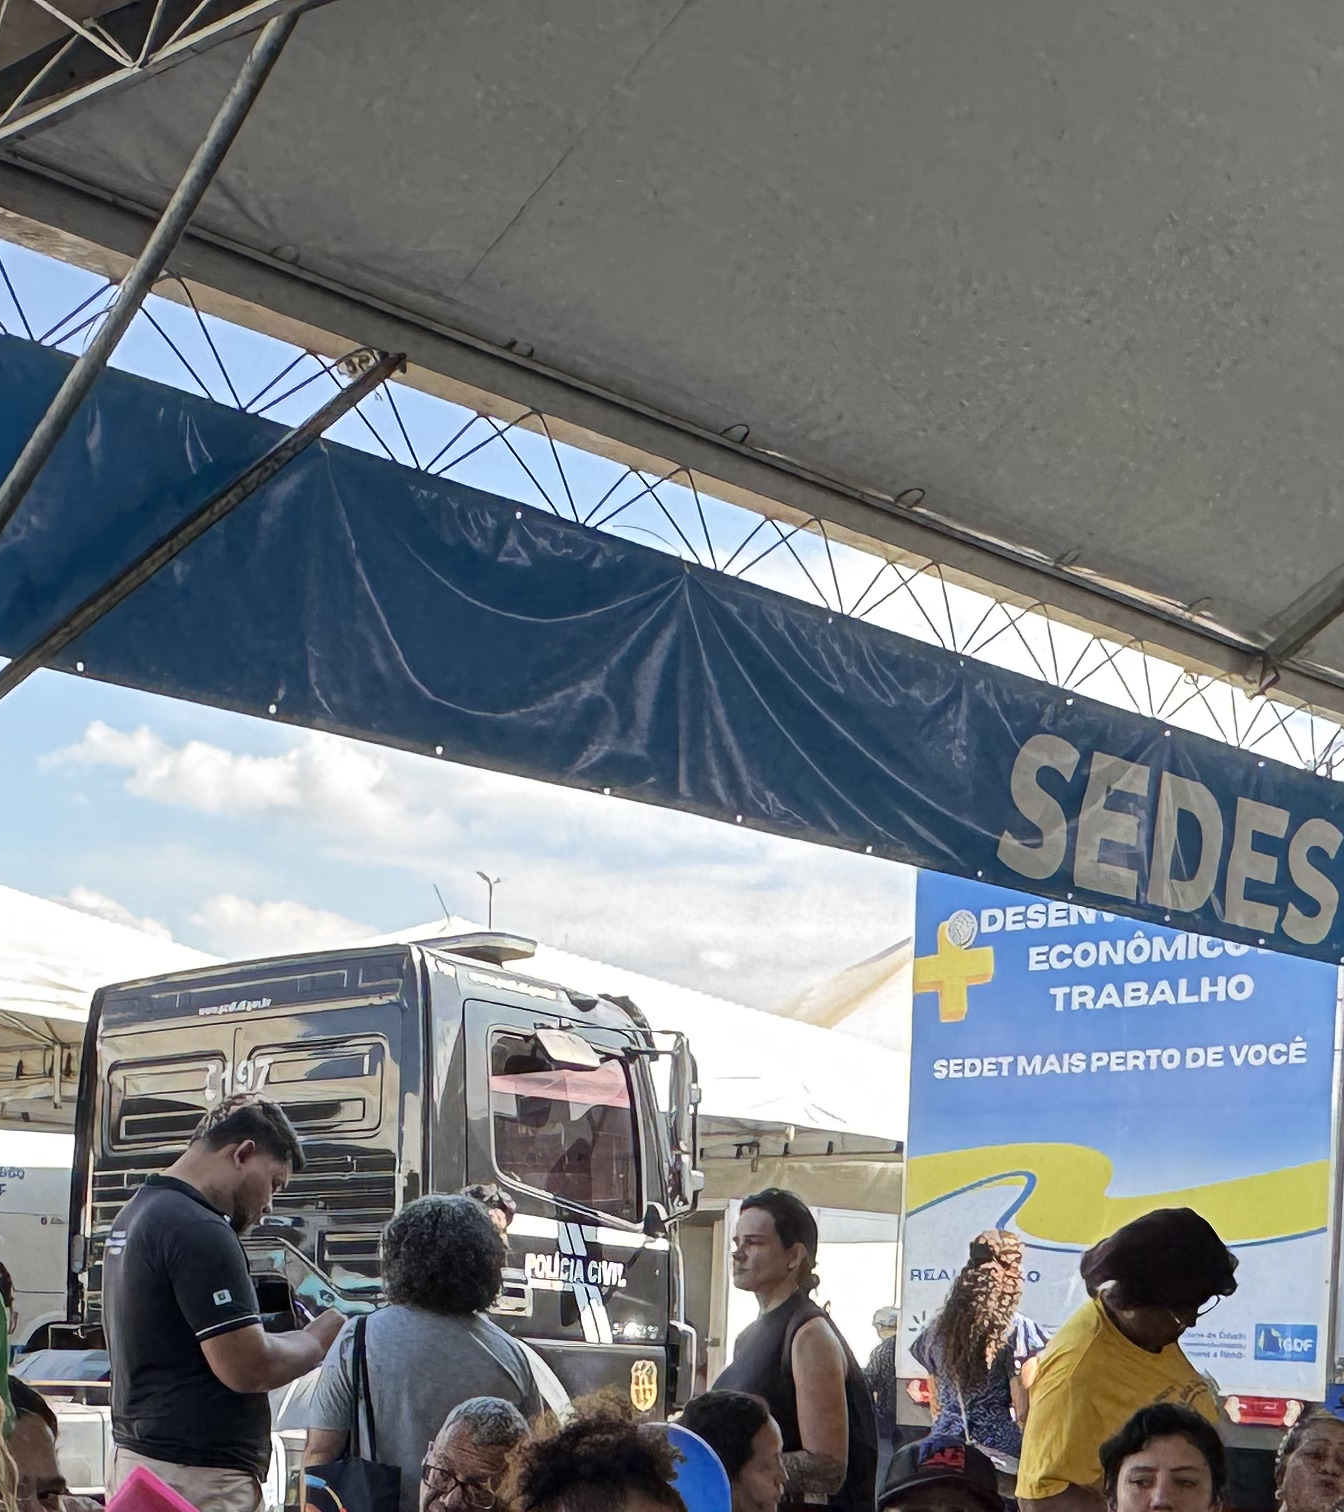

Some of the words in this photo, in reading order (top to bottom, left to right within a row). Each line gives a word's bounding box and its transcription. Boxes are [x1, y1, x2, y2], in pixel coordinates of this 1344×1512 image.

[997, 733, 1344, 945] SEDES
[1050, 974, 1255, 1012] TRABALHO
[933, 1055, 1014, 1080] SEDET
[1017, 1051, 1086, 1076] MAIS
[1090, 1047, 1181, 1073] PERTO
[1185, 1044, 1225, 1069] DE
[1229, 1035, 1307, 1067] VOCÊ
[525, 1251, 584, 1283] POLÍCIA
[588, 1260, 627, 1287] CIVIL
[1283, 1337, 1313, 1353] GDF
